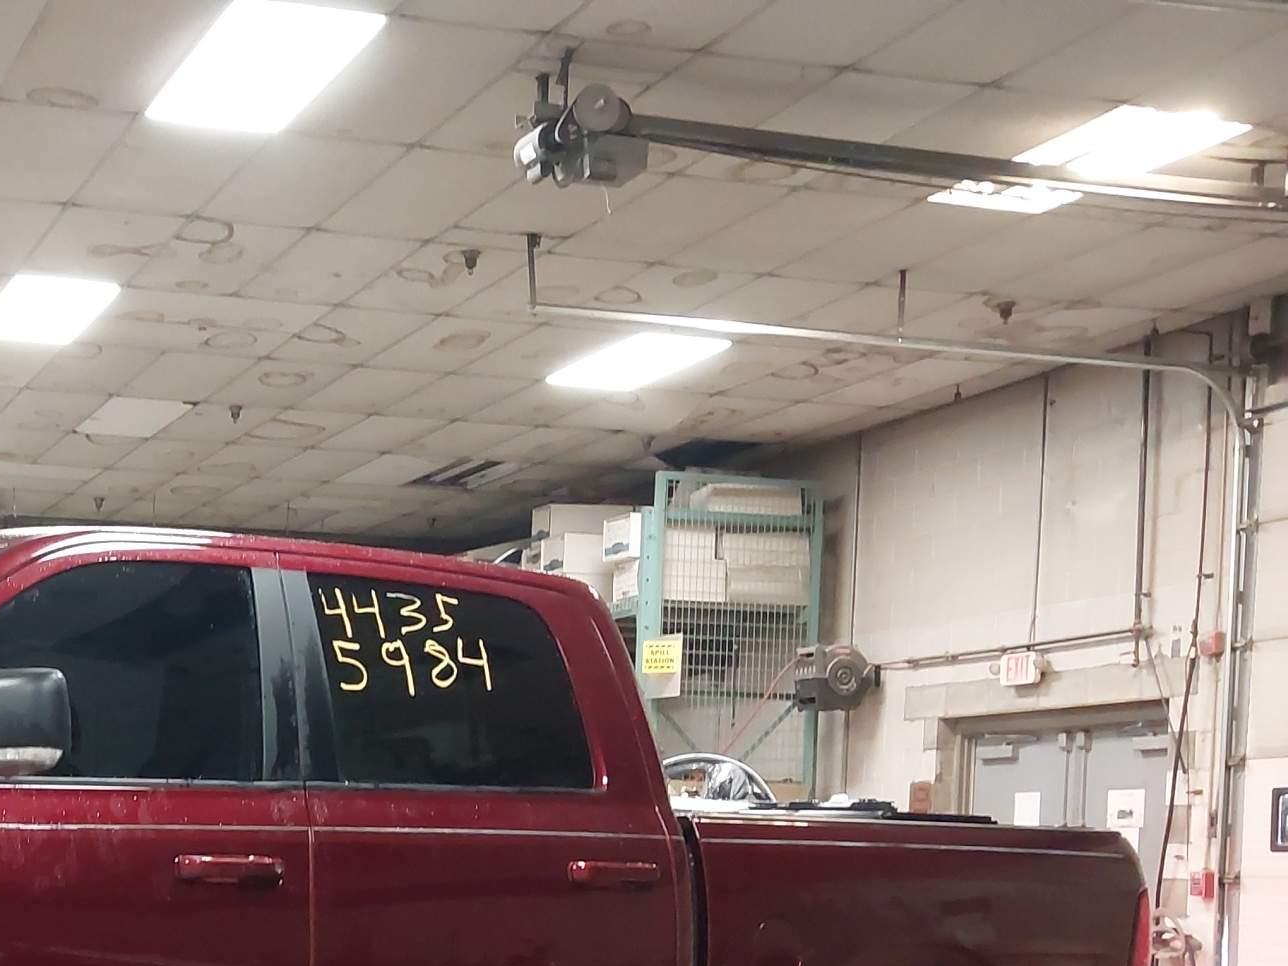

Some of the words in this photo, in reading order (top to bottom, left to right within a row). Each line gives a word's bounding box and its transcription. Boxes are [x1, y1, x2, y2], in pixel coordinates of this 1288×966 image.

[318, 587, 459, 639] 4435
[332, 636, 492, 697] 5984
[1006, 654, 1031, 682] EXIT
